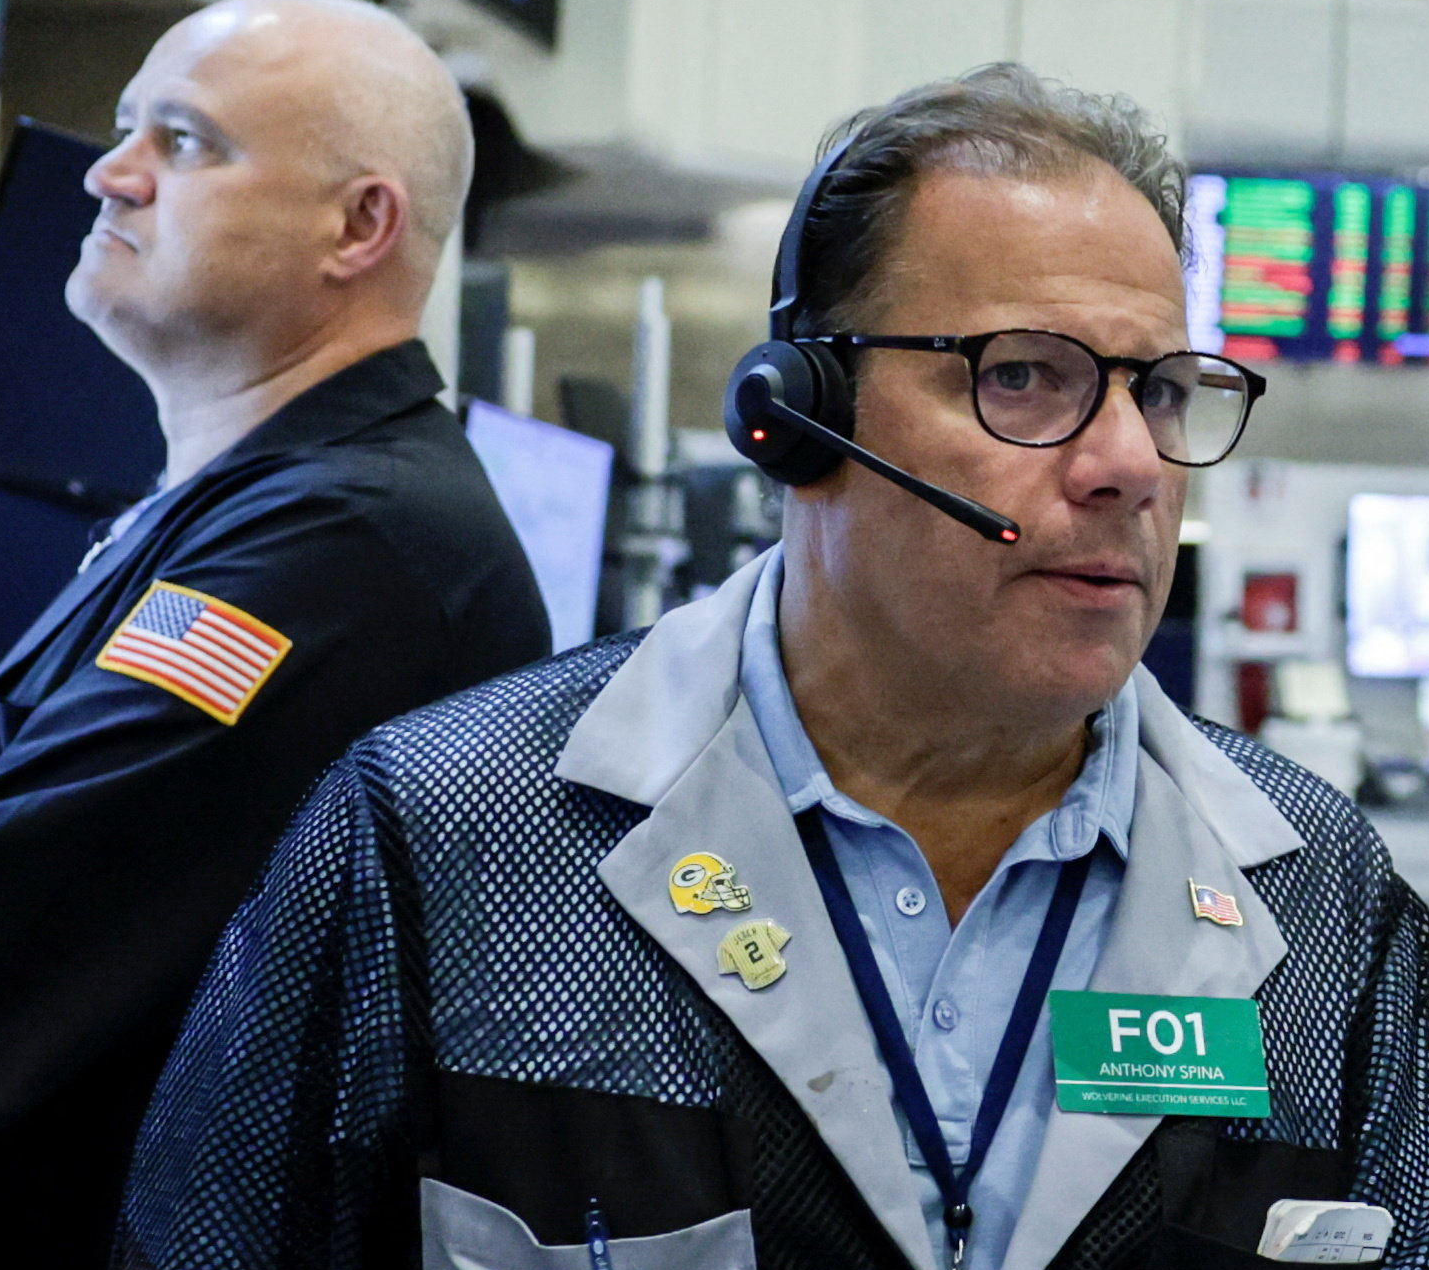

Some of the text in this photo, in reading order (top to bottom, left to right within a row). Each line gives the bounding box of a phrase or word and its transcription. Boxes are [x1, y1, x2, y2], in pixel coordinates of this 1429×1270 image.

[744, 940, 764, 964] 2
[1099, 1062, 1225, 1081] ANTHONY SPINA
[1081, 1091, 1135, 1103] WOLVERINE
[1136, 1093, 1188, 1105] EXECUTION
[1189, 1094, 1230, 1106] SERVICES
